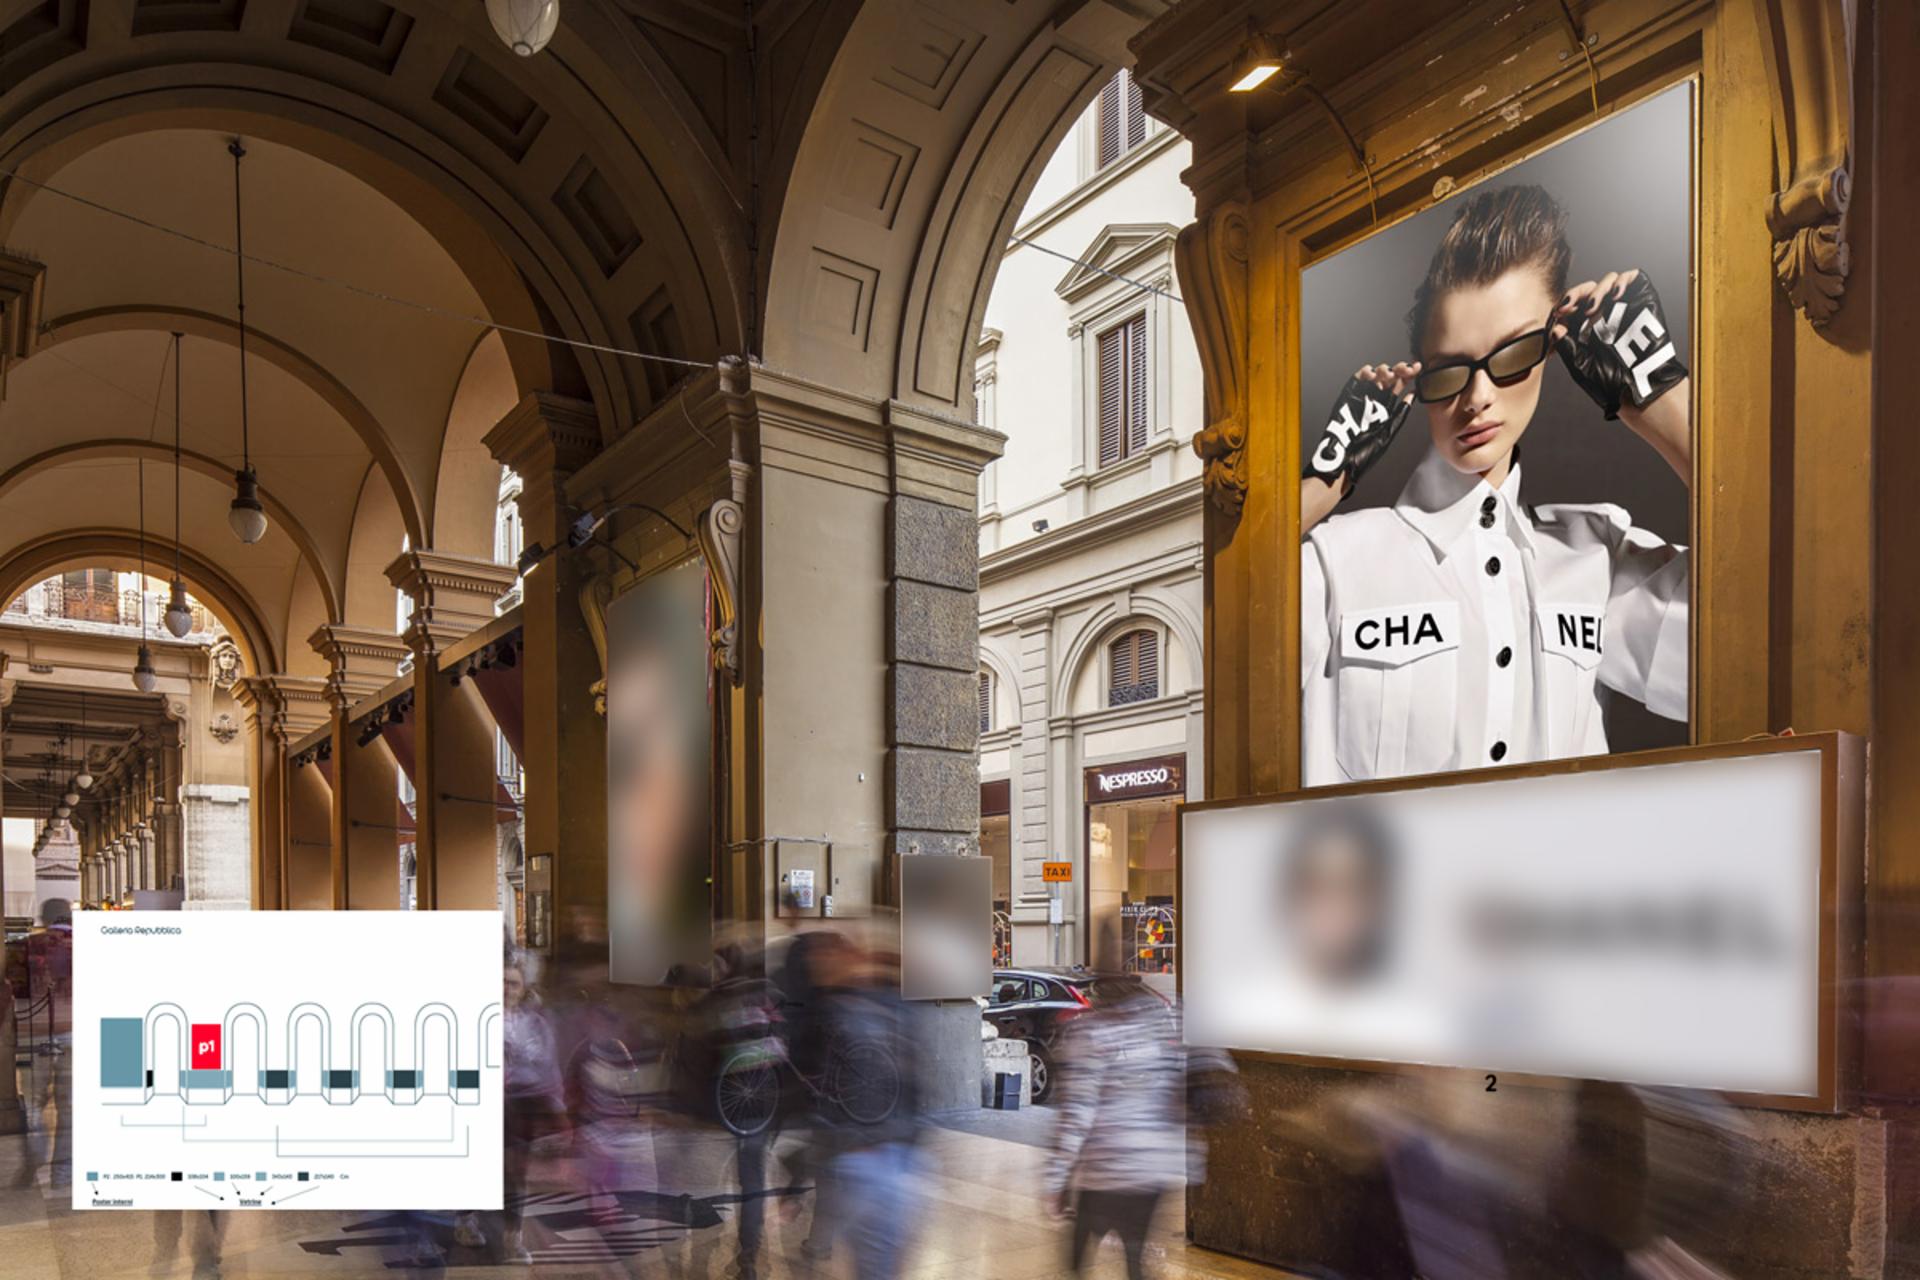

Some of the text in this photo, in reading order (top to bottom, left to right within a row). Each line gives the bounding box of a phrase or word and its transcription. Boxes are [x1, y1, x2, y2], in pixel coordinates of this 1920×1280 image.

[1312, 395, 1389, 472] CHA
[1355, 613, 1443, 650] CHA
[1098, 768, 1168, 792] NESPRESSO
[1046, 867, 1071, 877] TAXI
